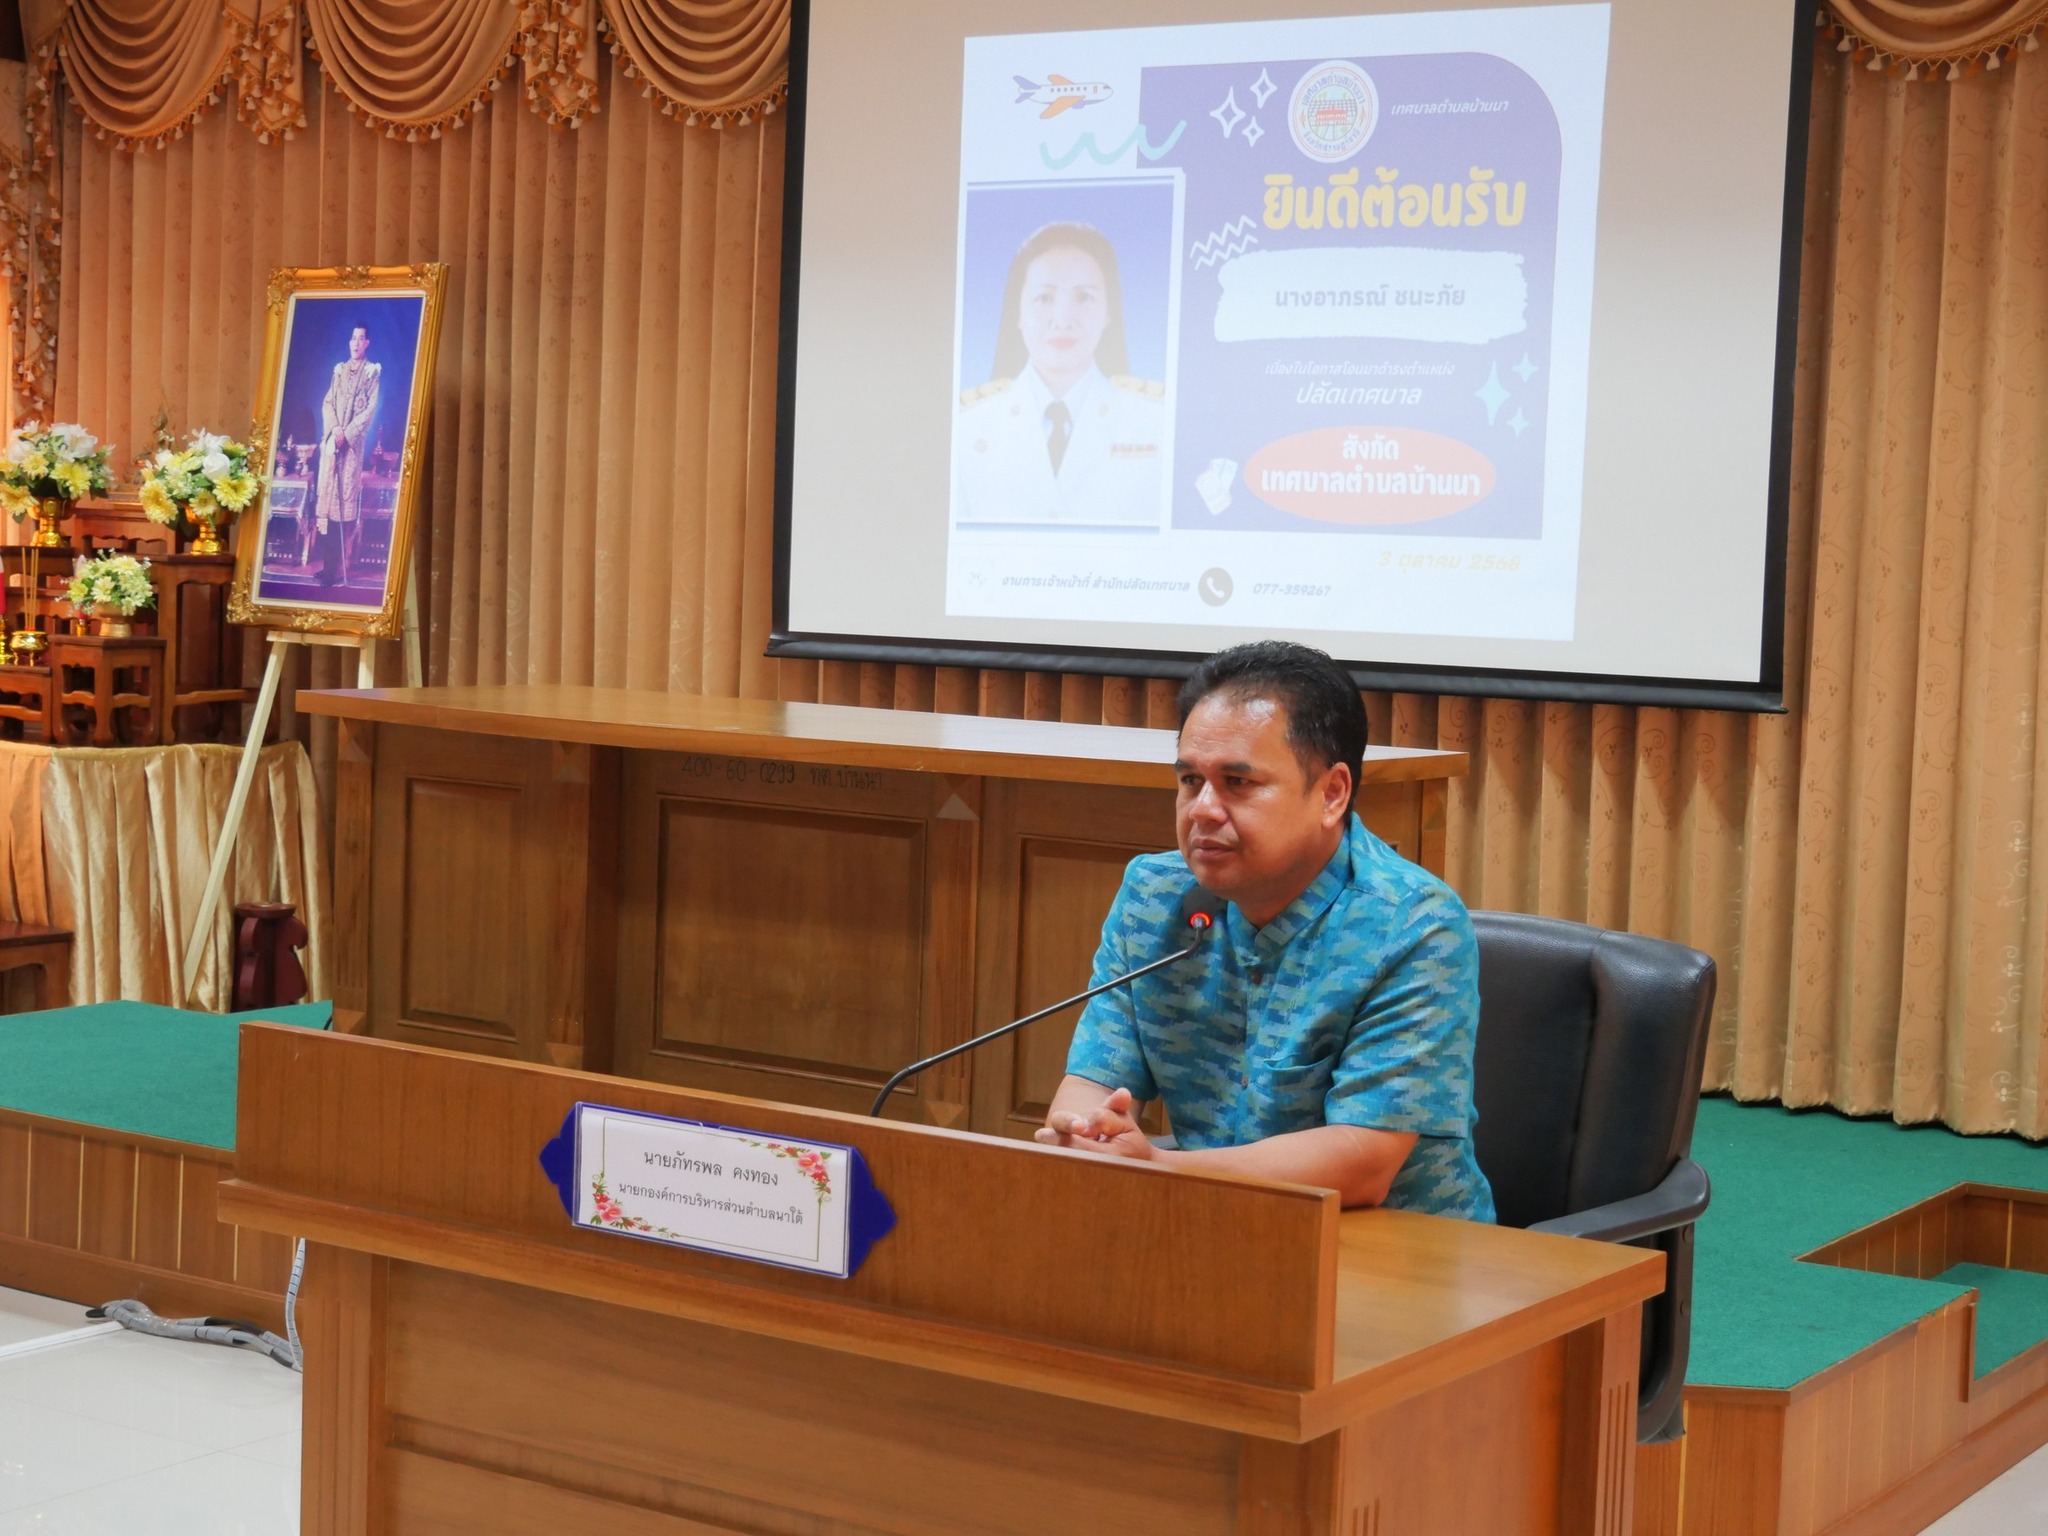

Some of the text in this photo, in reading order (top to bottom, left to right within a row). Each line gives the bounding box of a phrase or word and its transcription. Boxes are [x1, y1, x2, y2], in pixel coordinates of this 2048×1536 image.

[1391, 98, 1509, 115] เทศบาลตำบลบ้านนา
[1263, 166, 1526, 230] ยินดีต้อนรับ
[1275, 284, 1465, 307] นางอาภรณ์ ชนะภัย
[1296, 381, 1423, 406] ปลัดเทศบาล
[1342, 433, 1400, 461] สังกัด
[1261, 464, 1482, 497] เทศบาลตำบลบ้านนา
[1378, 550, 1393, 568] 3
[1398, 552, 1462, 575] ตุลาคม
[644, 1150, 779, 1187] นายภัทรพล คงทอง
[618, 1181, 804, 1226] นายกองค์การบริหารส่วนตำบลนาใต้
